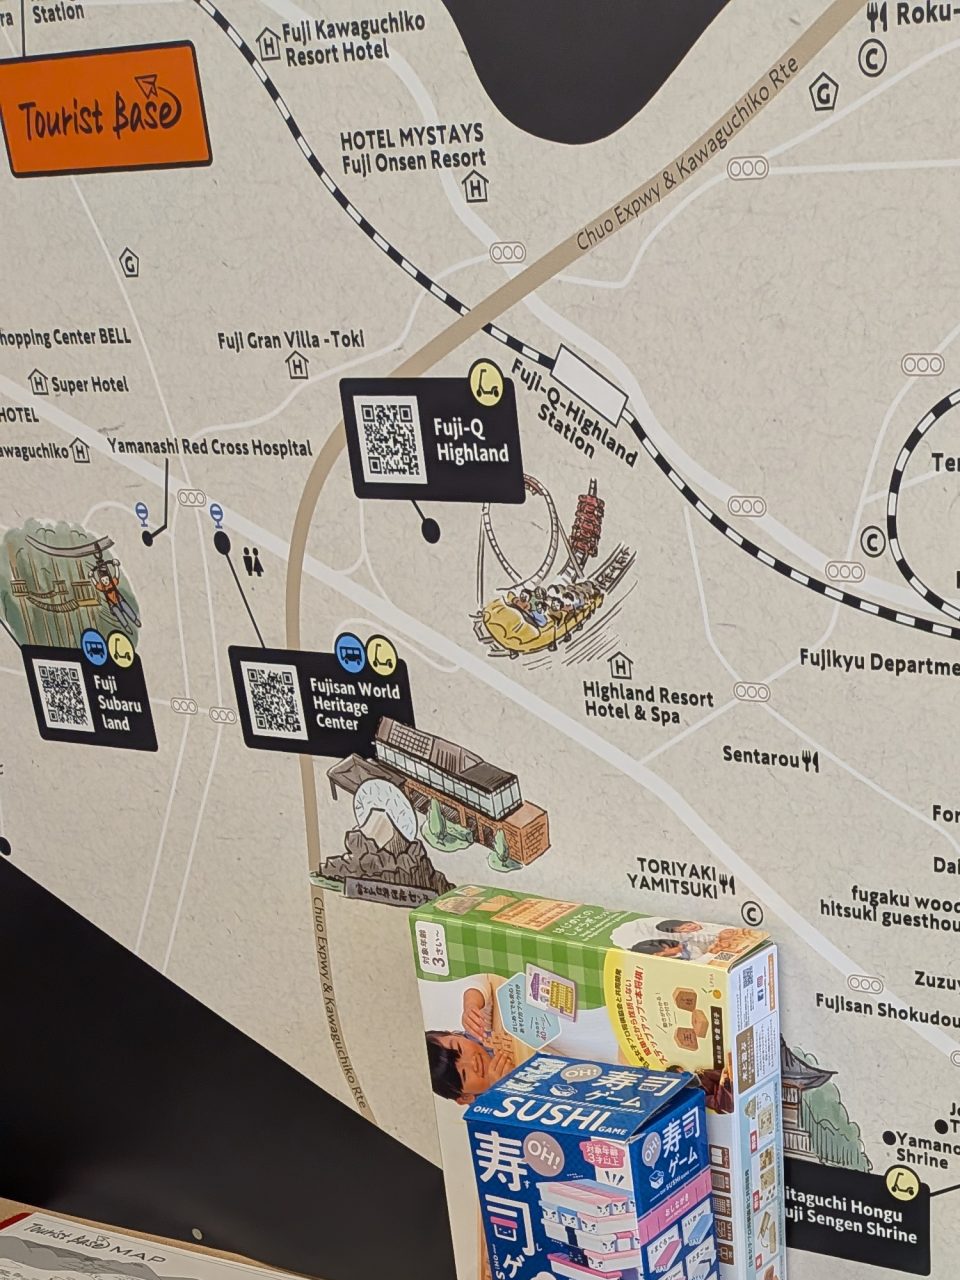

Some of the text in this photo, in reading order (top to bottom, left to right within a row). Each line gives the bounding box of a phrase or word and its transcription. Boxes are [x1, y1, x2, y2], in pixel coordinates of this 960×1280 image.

[282, 12, 426, 45] Fuji Kawaguchiko
[286, 39, 389, 67] Resort Hotel
[19, 87, 182, 140] Tourist Base
[340, 123, 484, 151] HOTEL MYSTAYS
[342, 149, 487, 178] Fuji Onsen Resort
[511, 358, 638, 468] Fuji-Q-Highland
[434, 418, 484, 440] Fuji-Q
[538, 404, 596, 459] Station
[107, 437, 313, 458] Yamanashi Red Cross Hospital
[436, 442, 509, 466] Highland
[799, 648, 865, 672] Fujikyu
[94, 675, 118, 693] Fuji
[310, 677, 401, 700] Fujisan World
[98, 695, 142, 714] Subaru
[313, 696, 369, 717] Heritage
[103, 713, 131, 731] land
[316, 713, 359, 731] Center
[722, 746, 800, 769] Sentarou
[637, 857, 717, 881] TORIYAKI
[627, 873, 718, 900] YAMITSUKI
[592, 1070, 681, 1096] 寿司
[473, 1096, 628, 1136] OH! SUSHI GAME
[662, 1106, 701, 1159] 寿司
[896, 1147, 949, 1170] Shrine
[24, 1223, 69, 1243] Tourist
[110, 1246, 166, 1263] MAP
